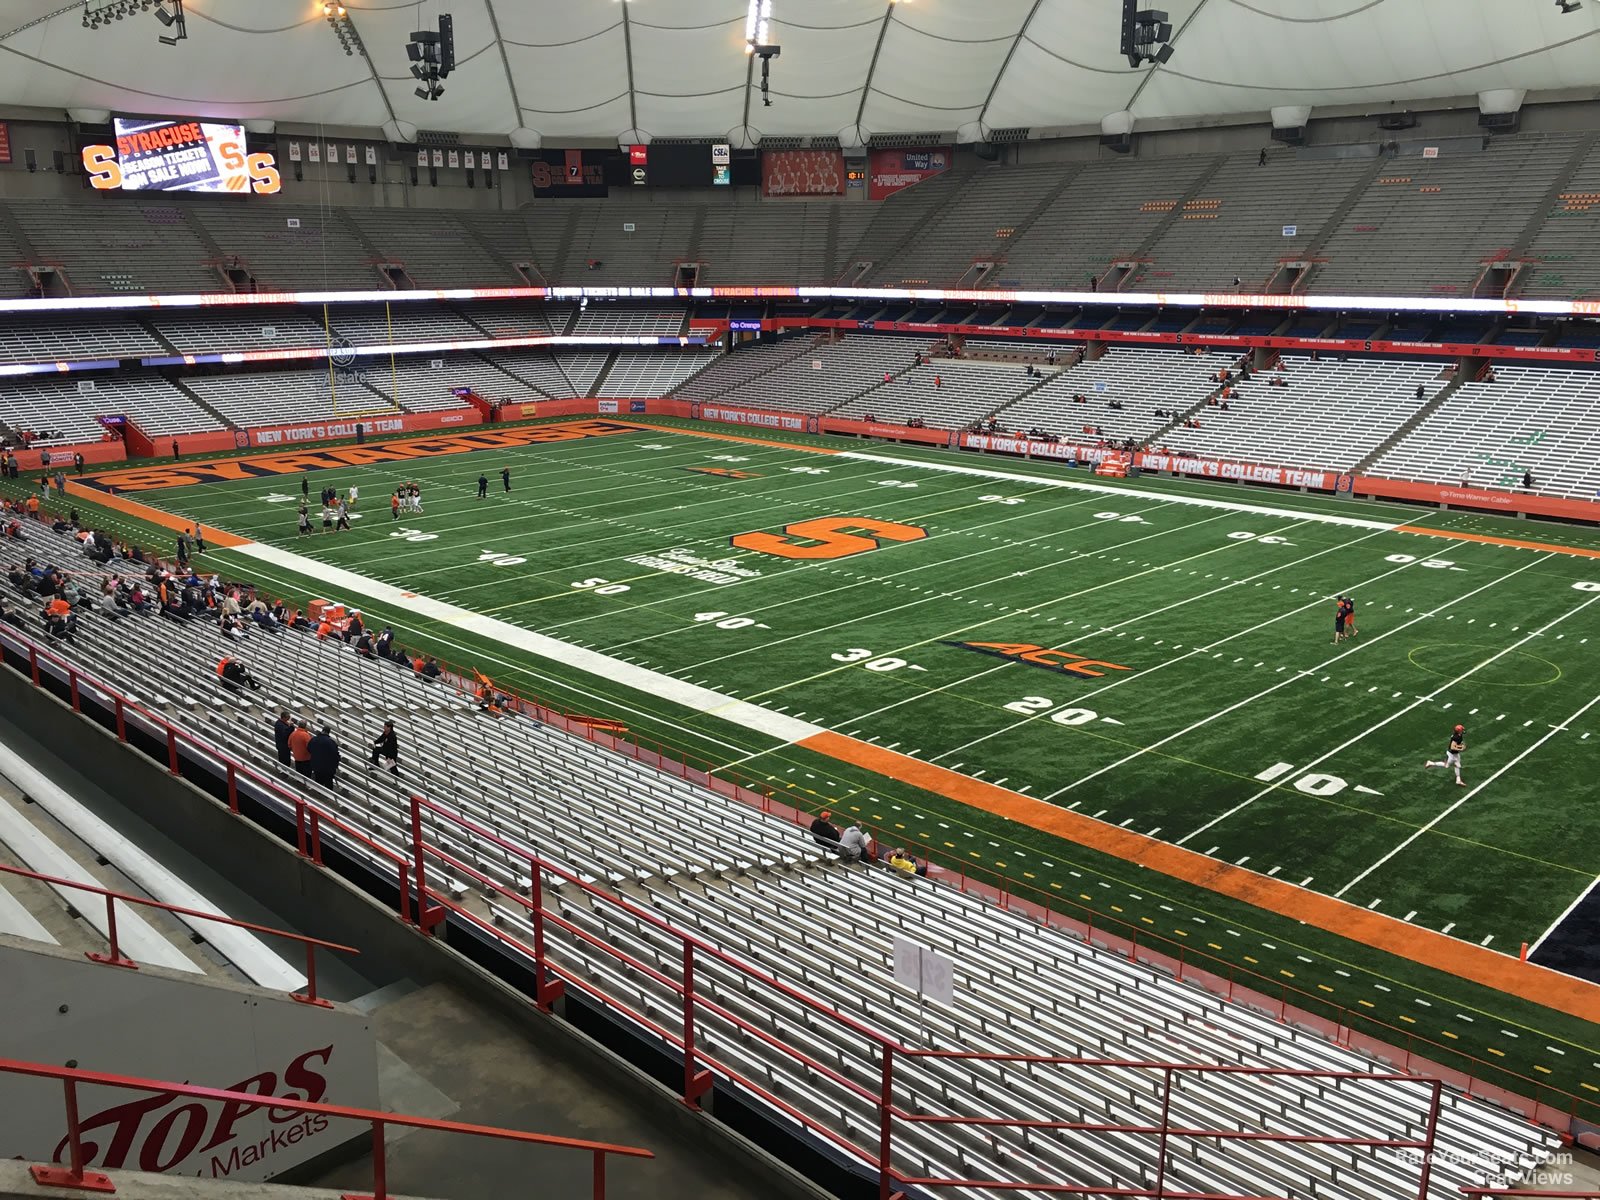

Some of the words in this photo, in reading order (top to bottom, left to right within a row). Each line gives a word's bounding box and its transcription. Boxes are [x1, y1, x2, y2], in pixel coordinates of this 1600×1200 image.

[117, 122, 204, 155] SYRACUSE
[82, 144, 122, 190] S
[165, 147, 207, 169] TICKETS
[219, 142, 244, 170] S
[906, 153, 928, 161] United
[914, 161, 928, 169] Way
[148, 167, 179, 185] SALE
[247, 152, 281, 194] S
[571, 167, 577, 176] 7
[200, 293, 248, 305] SYRACUSE
[252, 292, 295, 304] FOOTBALL
[713, 287, 756, 296] SYRACUSE
[1203, 294, 1254, 306] SYRACUSE
[1257, 295, 1306, 307] FOOTBALL
[323, 372, 368, 388] Allstate
[703, 407, 718, 418] NEW
[720, 409, 746, 420] YORK'S
[747, 412, 780, 426] COLLEGE
[781, 416, 802, 429] TEAM
[235, 431, 249, 447] S
[256, 430, 282, 443] NEW
[283, 426, 324, 440] YORK'S
[374, 419, 403, 432] TEAM
[94, 422, 640, 490] SYRACUSE
[966, 434, 989, 449] NEW
[991, 437, 1028, 453] YORK'S
[1030, 442, 1077, 459] COLLEGE
[1141, 454, 1170, 470] NEW
[1172, 458, 1219, 476] YORK'S
[1222, 463, 1282, 483] COLLEGE
[1285, 469, 1325, 487] TEAM
[1337, 475, 1352, 492] S
[1449, 491, 1465, 499] Time
[1466, 493, 1490, 502] Warner
[730, 516, 929, 560] S
[623, 554, 698, 574] LEGENDS
[685, 569, 741, 584] FIELD
[571, 577, 631, 594] 50
[694, 611, 755, 629] 40
[831, 648, 907, 671] 30
[963, 641, 1134, 677] ACC
[1002, 696, 1098, 725] 20
[1254, 761, 1349, 796] 10
[52, 1044, 333, 1172] TOPS
[211, 1112, 331, 1178] Markets
